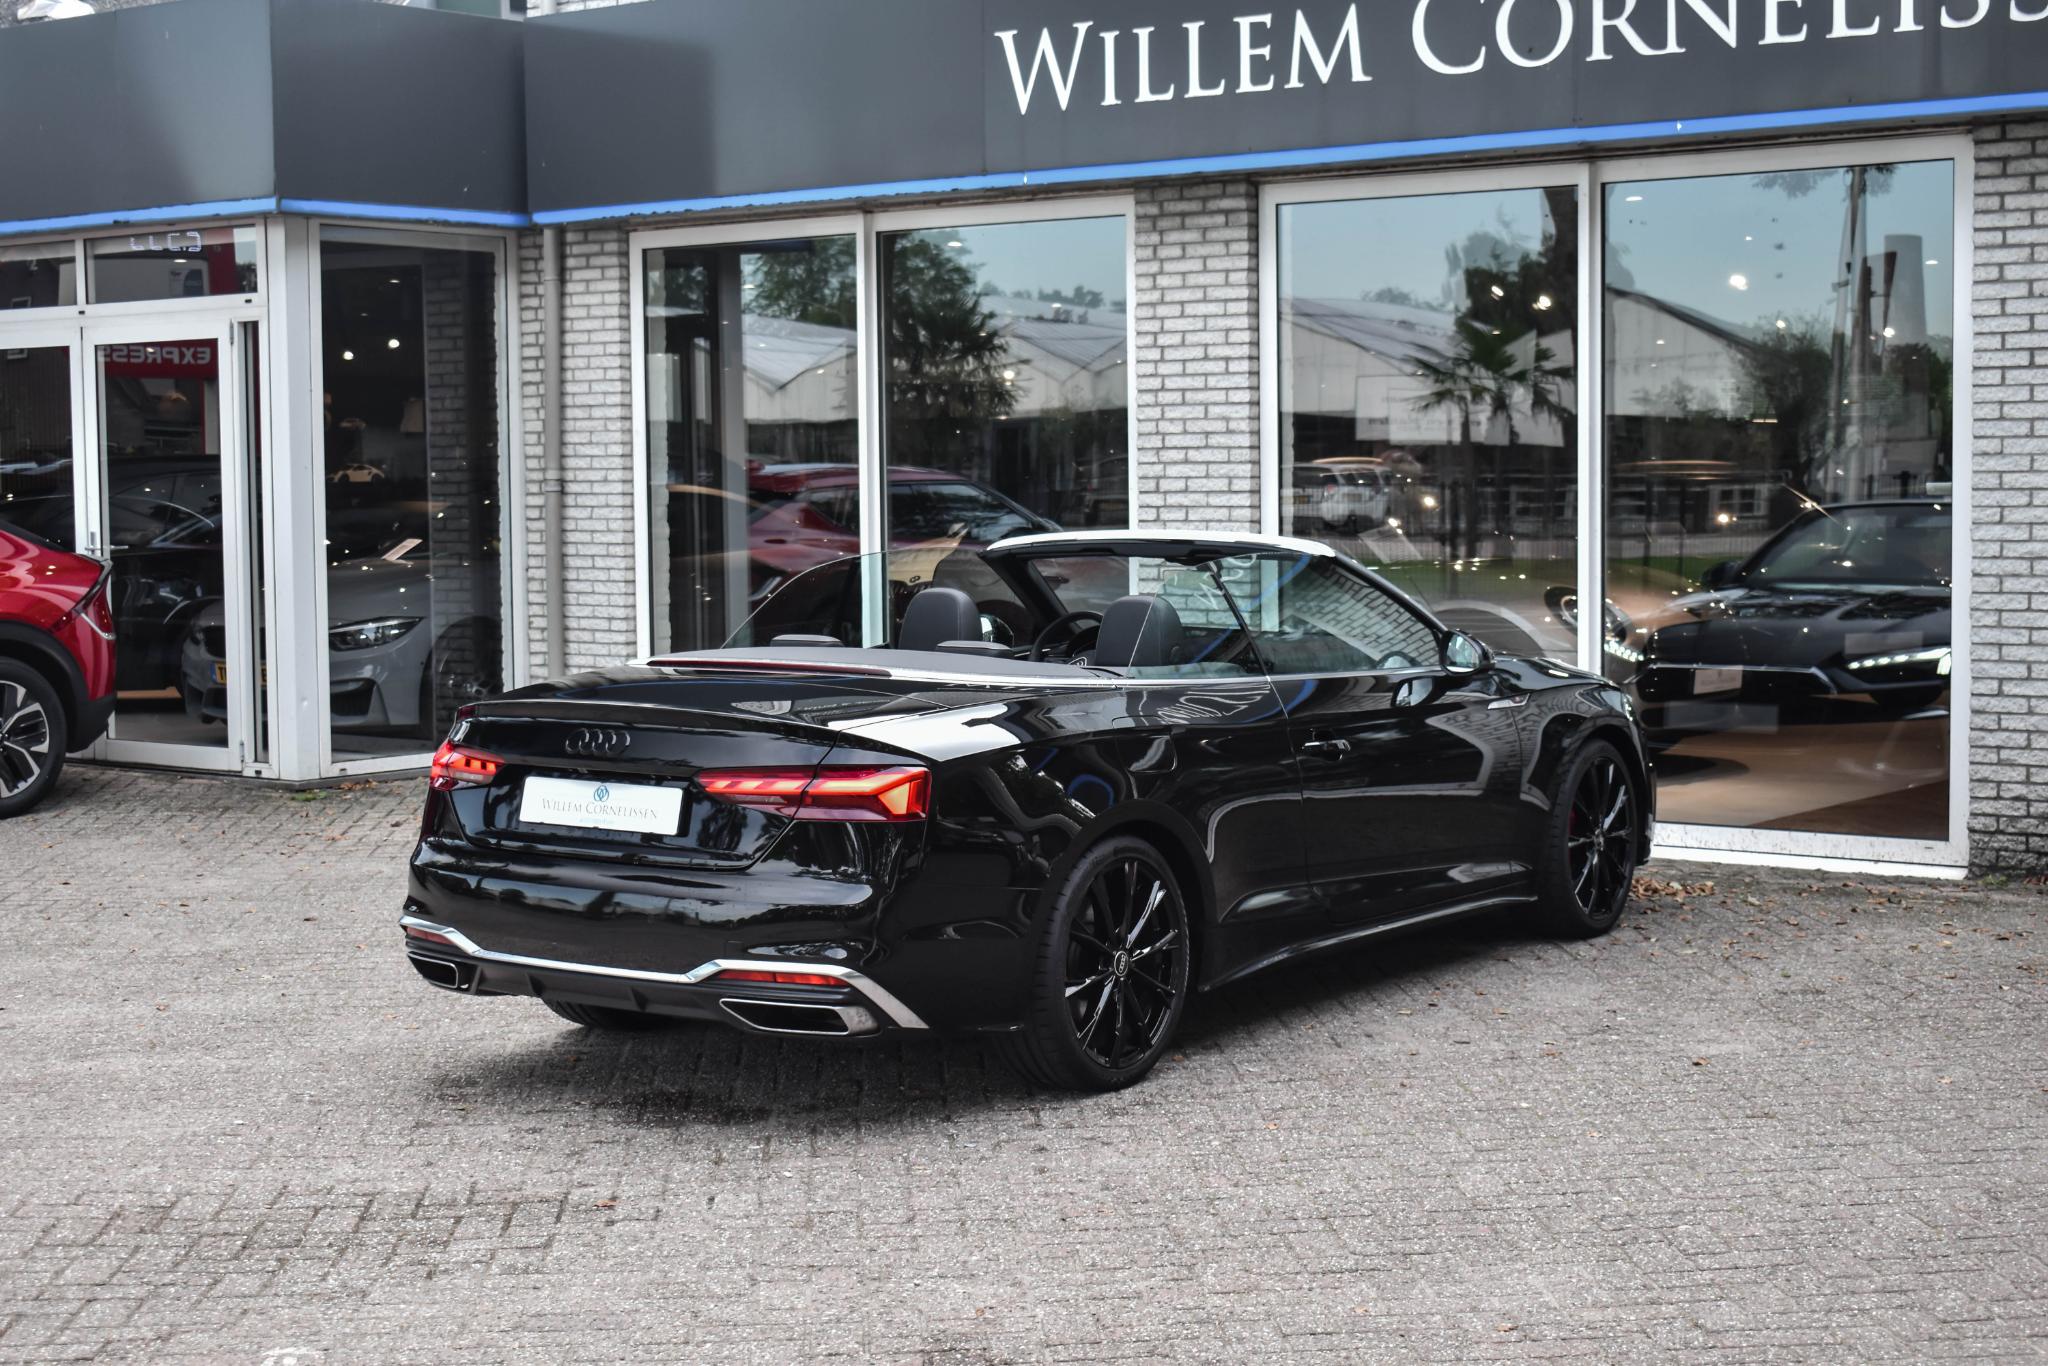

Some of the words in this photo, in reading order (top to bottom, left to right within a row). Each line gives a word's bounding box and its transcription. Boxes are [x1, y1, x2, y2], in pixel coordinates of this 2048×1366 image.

[994, 3, 1373, 115] WILLEM
[542, 798, 582, 814] WILLEM
[585, 801, 658, 819] CORNELISSEN
